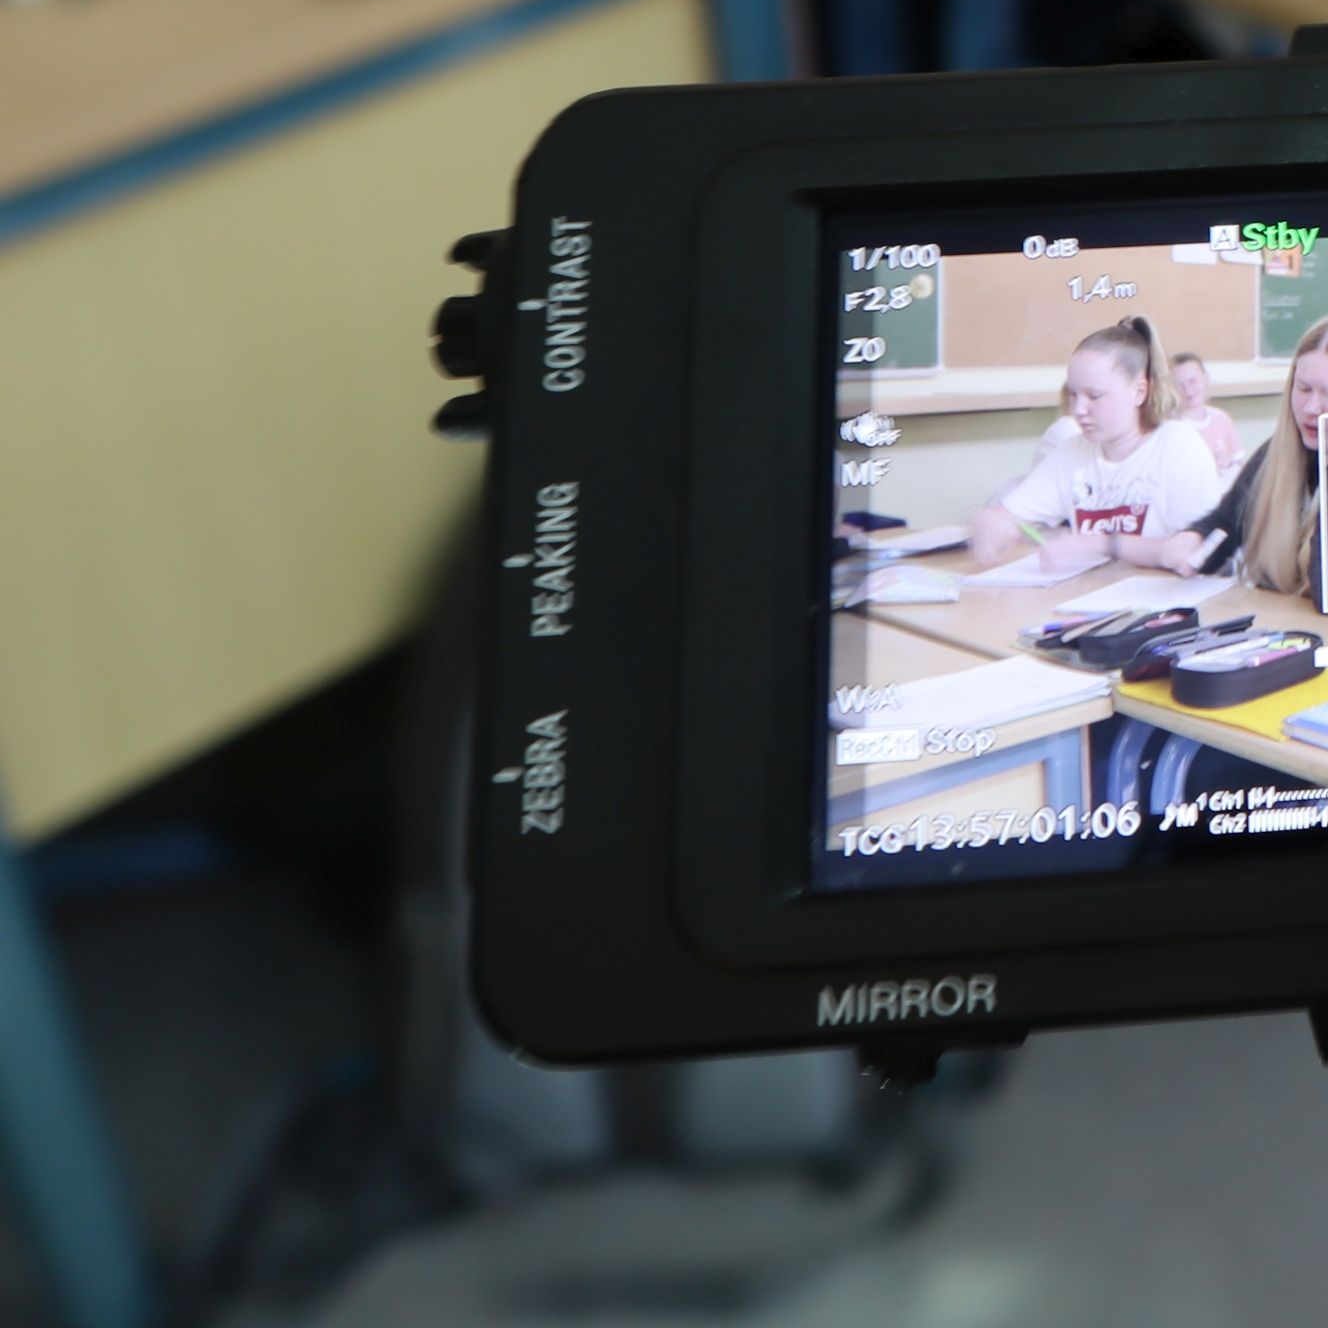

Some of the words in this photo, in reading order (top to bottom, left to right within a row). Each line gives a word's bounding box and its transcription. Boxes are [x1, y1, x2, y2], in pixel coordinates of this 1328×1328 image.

[848, 243, 942, 272] 1/100
[1242, 221, 1321, 256] Stby
[541, 216, 593, 393] CONTRAST
[841, 458, 893, 487] MF
[530, 481, 581, 638] PEAKING
[925, 725, 997, 757] Stop
[520, 708, 569, 835] ZEBRA
[816, 973, 998, 1027] MIRROR
